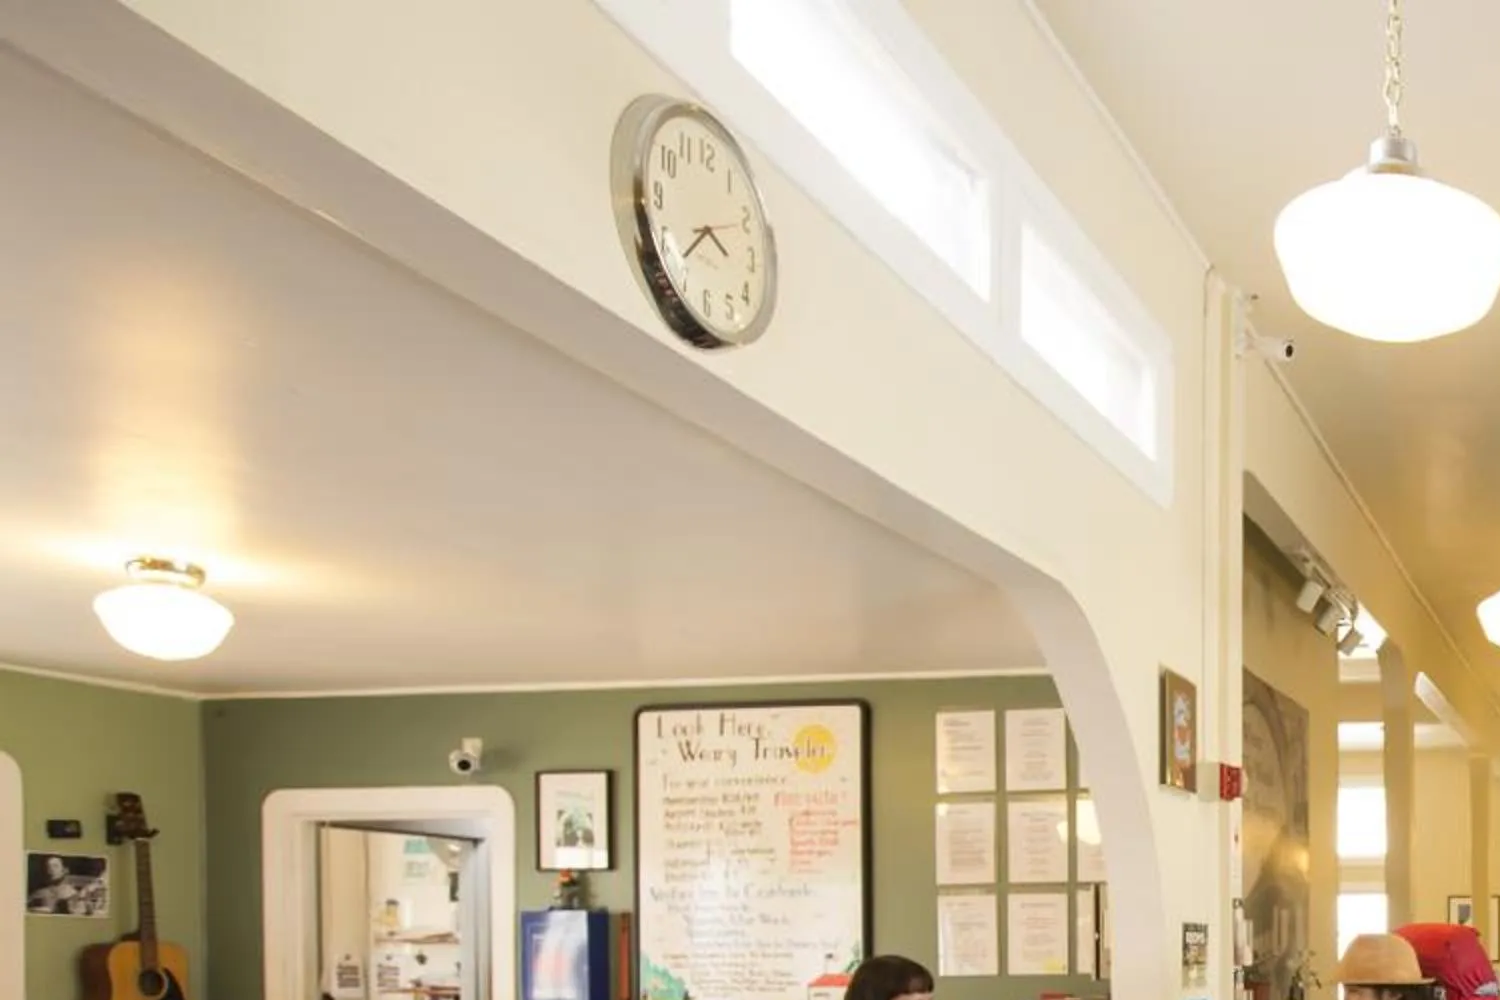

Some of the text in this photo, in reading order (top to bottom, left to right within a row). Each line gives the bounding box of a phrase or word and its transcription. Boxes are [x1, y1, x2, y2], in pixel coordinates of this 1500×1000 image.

[661, 143, 677, 179] 10
[679, 131, 692, 165] 11
[699, 137, 716, 174] 12
[653, 180, 664, 211] 9
[741, 205, 751, 236] 2
[702, 288, 712, 319] 6
[725, 292, 735, 321] 5
[741, 280, 751, 307] 4
[656, 713, 704, 739] Look
[677, 739, 738, 769] Weary
